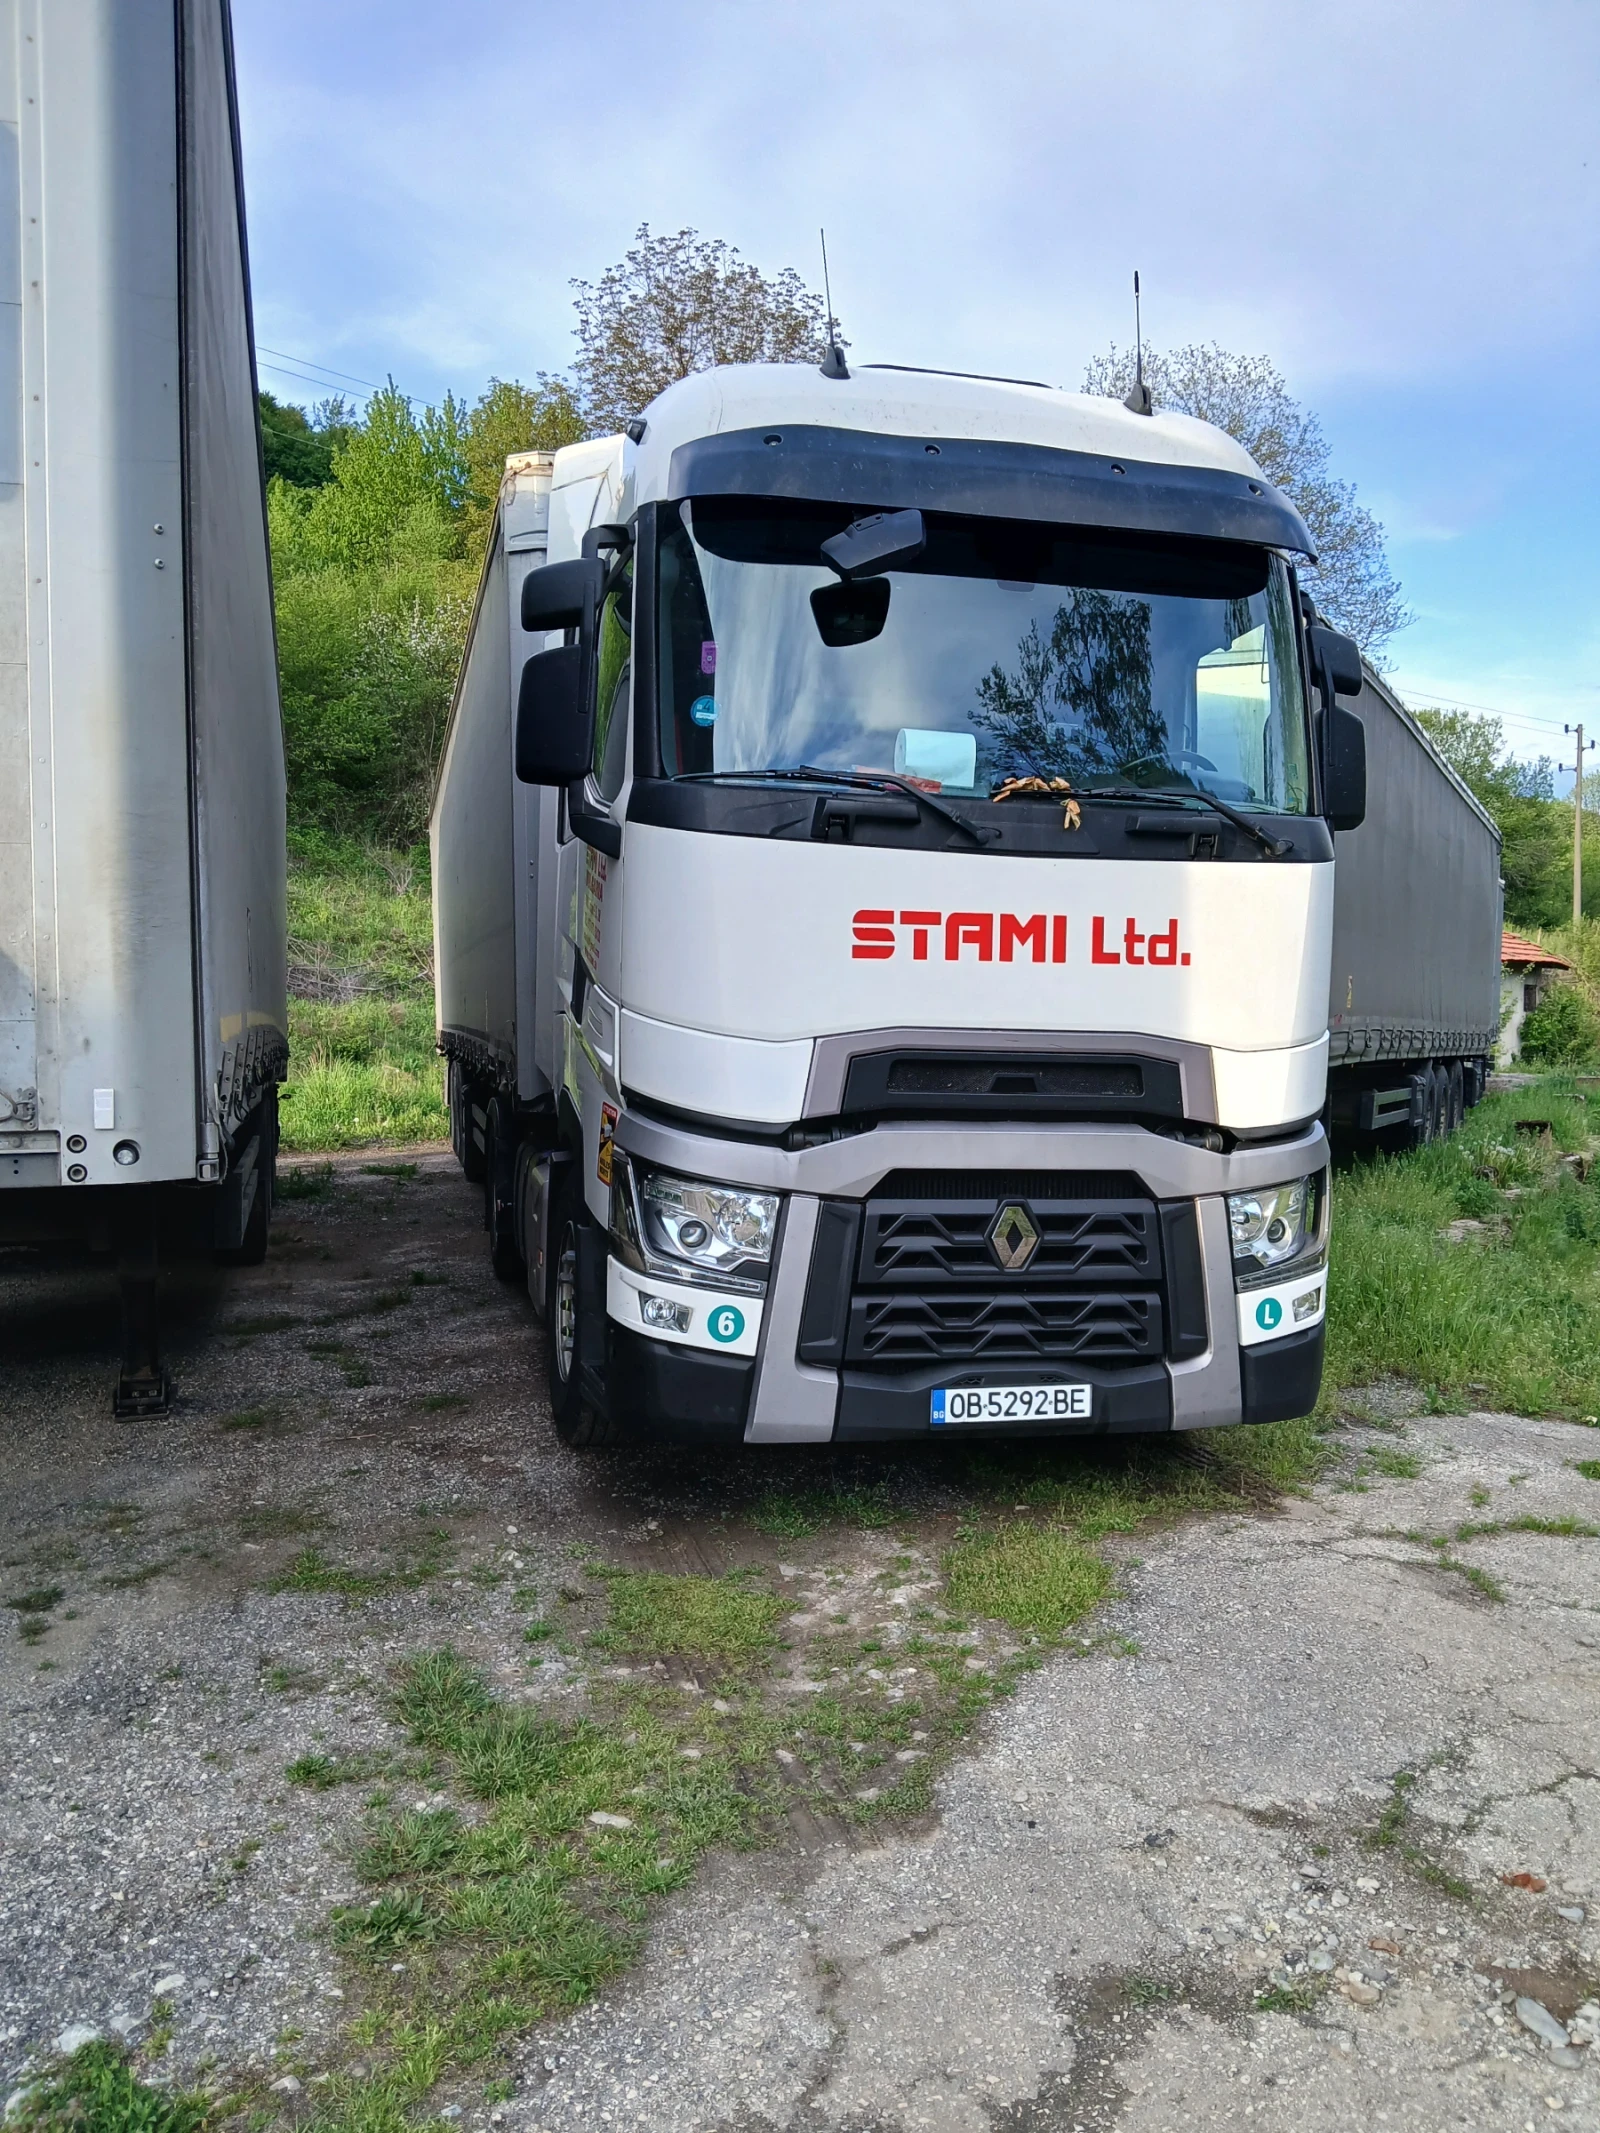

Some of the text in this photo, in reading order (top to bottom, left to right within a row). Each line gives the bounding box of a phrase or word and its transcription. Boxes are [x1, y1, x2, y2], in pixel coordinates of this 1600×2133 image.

[852, 909, 1191, 966] STAMI Ltd.
[717, 1311, 735, 1336] 6
[1263, 1304, 1275, 1324] L
[933, 1411, 945, 1419] BG
